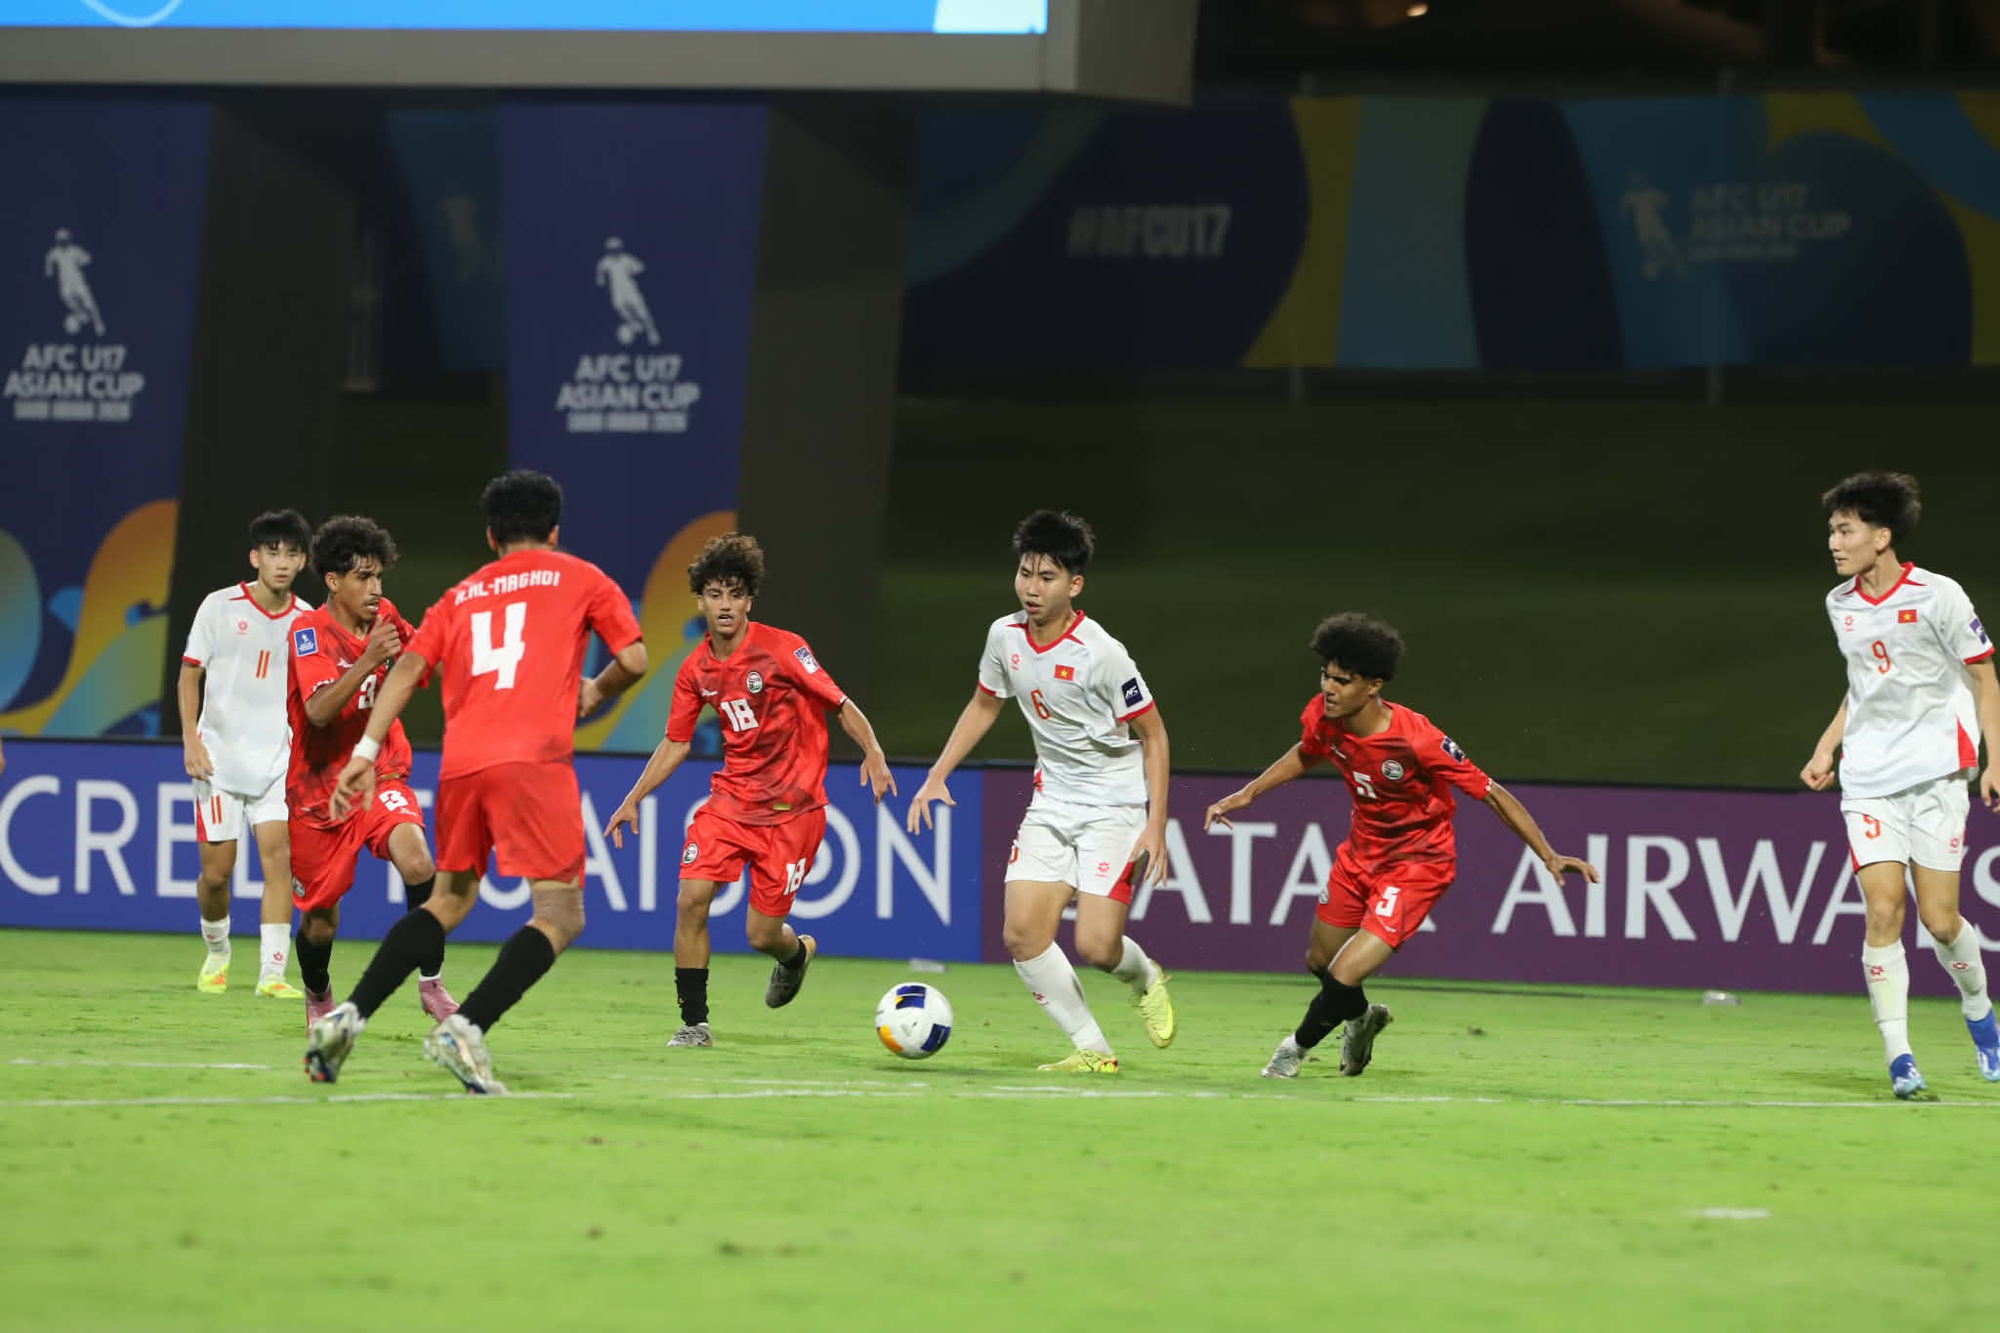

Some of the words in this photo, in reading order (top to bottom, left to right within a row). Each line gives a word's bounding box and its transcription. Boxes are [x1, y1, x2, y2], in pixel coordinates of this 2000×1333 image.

[22, 344, 77, 371] AFC
[81, 344, 126, 371] U17
[574, 354, 630, 382] AFC
[634, 354, 682, 382] U17
[4, 371, 84, 399] ASIAN
[87, 372, 145, 399] CUP
[555, 382, 639, 411] ASIAN
[642, 382, 702, 410] CUP
[471, 601, 527, 690] 4
[1872, 640, 1891, 674] 9
[255, 649, 270, 679] 11
[720, 698, 759, 732] 18
[1031, 689, 1050, 719] 6
[1352, 771, 1378, 800] 5
[210, 795, 222, 825] 11
[783, 857, 807, 895] 18
[1375, 885, 1401, 917] 5
